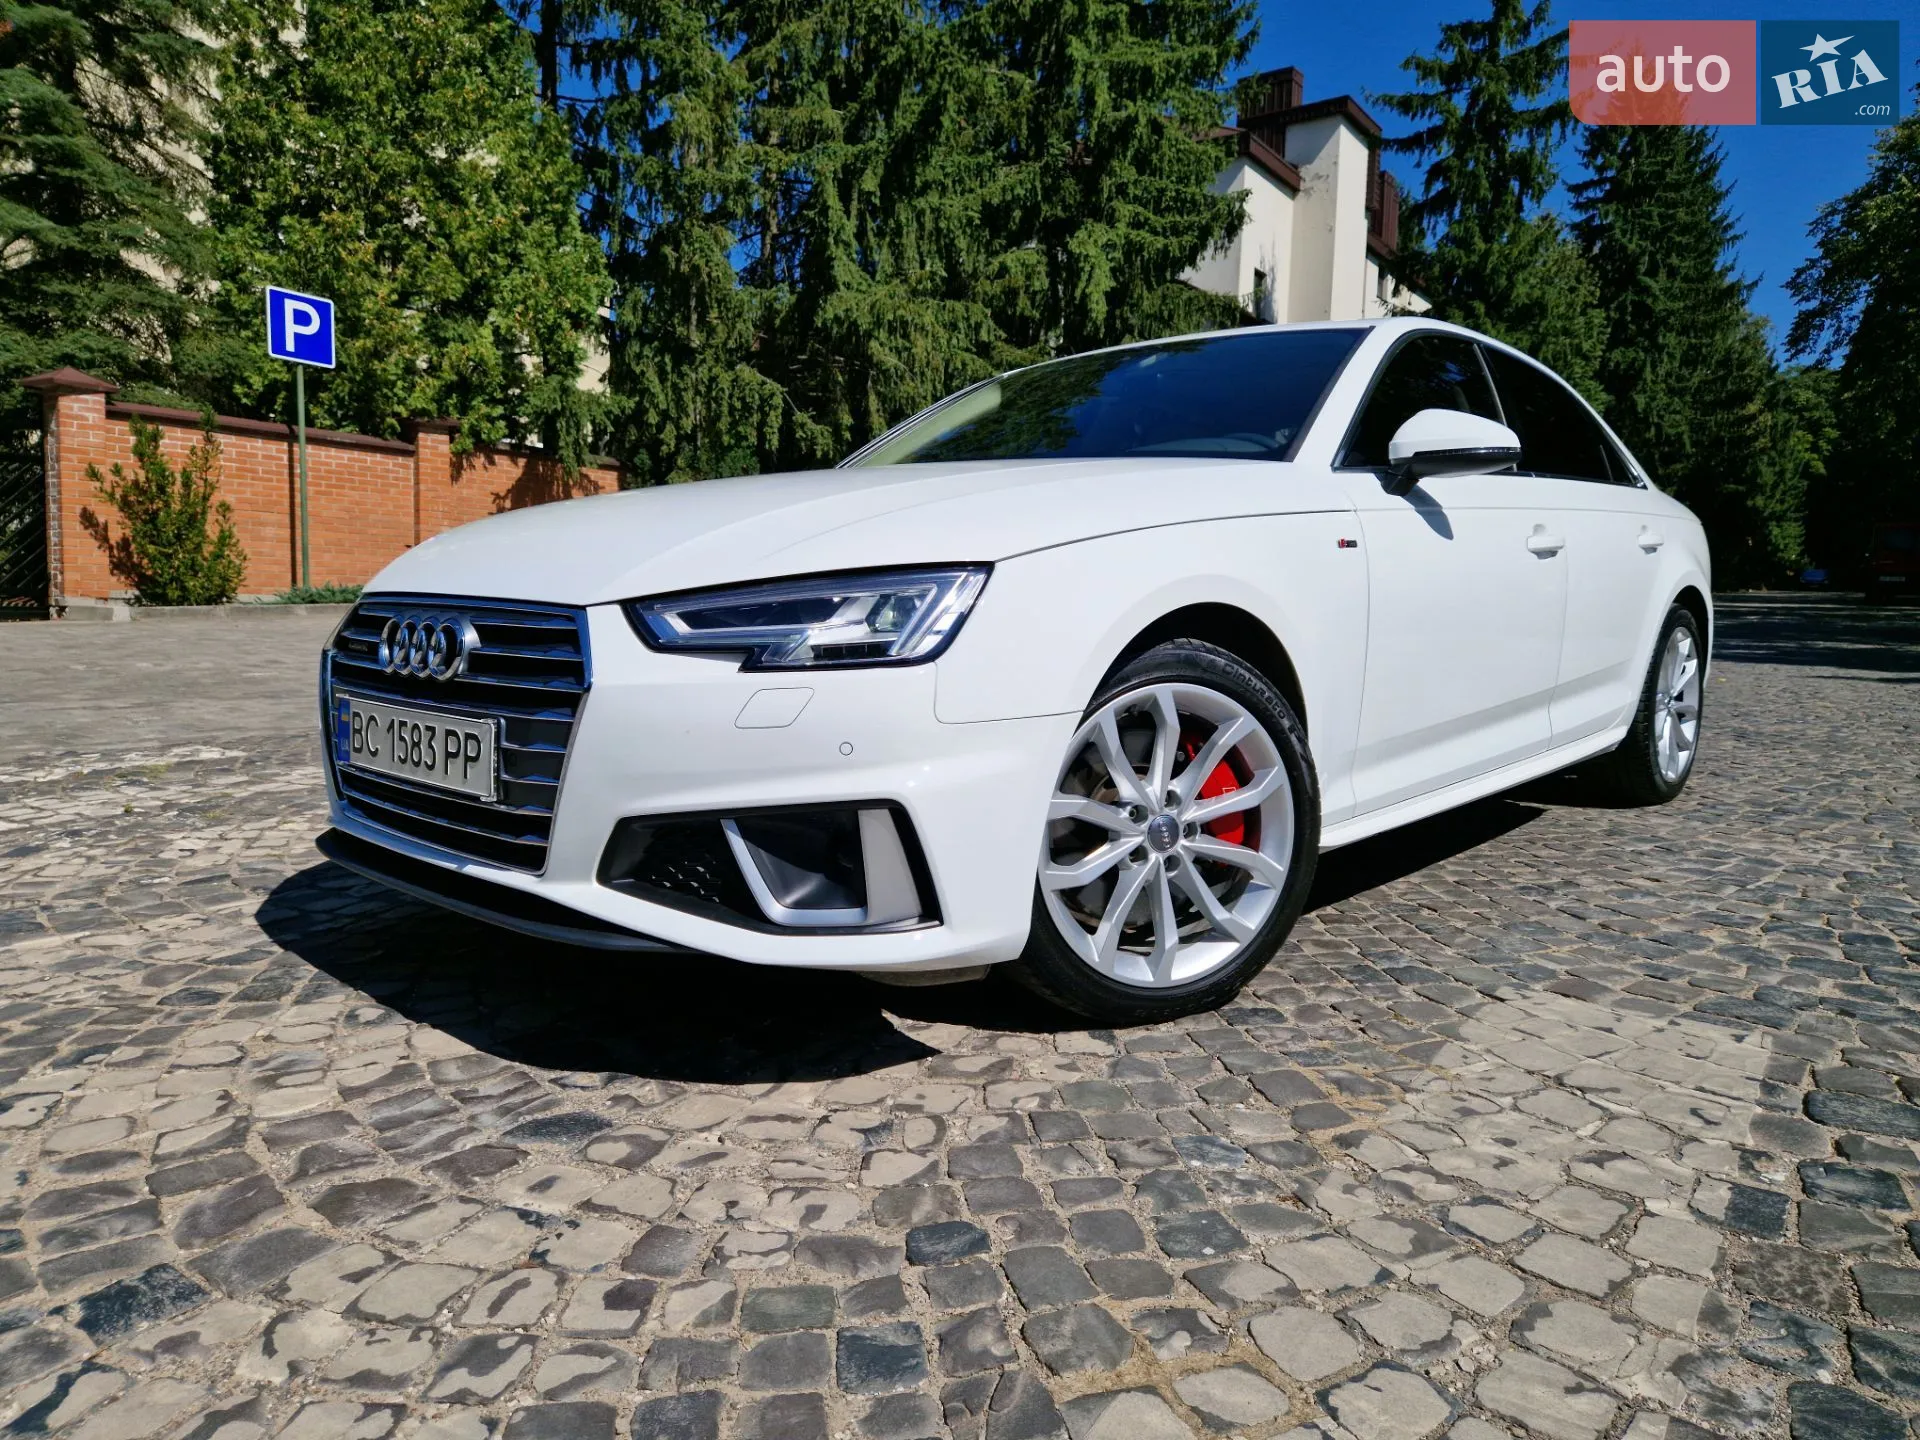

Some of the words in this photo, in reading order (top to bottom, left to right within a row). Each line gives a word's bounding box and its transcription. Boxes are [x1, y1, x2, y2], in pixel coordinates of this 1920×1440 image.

[284, 298, 320, 352] P
[352, 711, 380, 758] BC
[386, 718, 437, 771] 1583
[445, 728, 482, 780] PP
